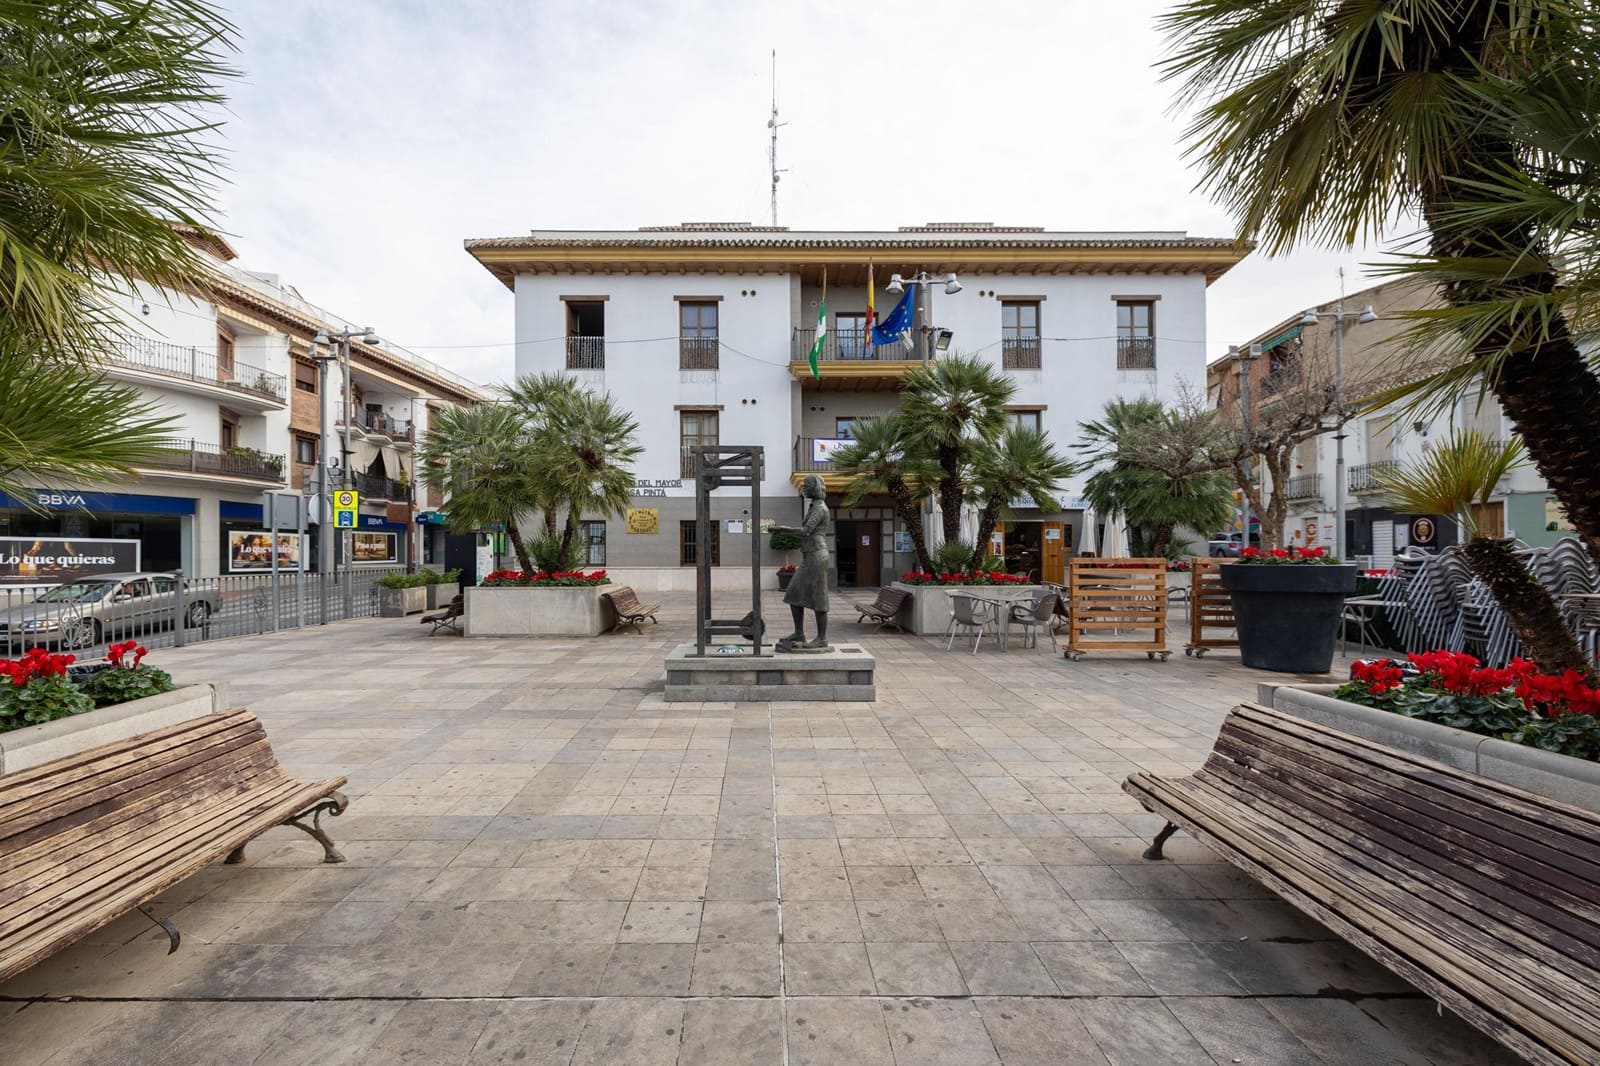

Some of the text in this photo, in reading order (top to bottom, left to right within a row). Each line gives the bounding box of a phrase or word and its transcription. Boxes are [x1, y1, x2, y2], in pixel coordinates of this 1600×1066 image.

[638, 480, 682, 488] DEL MAYOR
[643, 489, 666, 497] PINTA
[38, 494, 86, 505] BBVA
[240, 544, 252, 553] Lo
[252, 546, 267, 555] que
[0, 553, 116, 568] Lo que quieras
